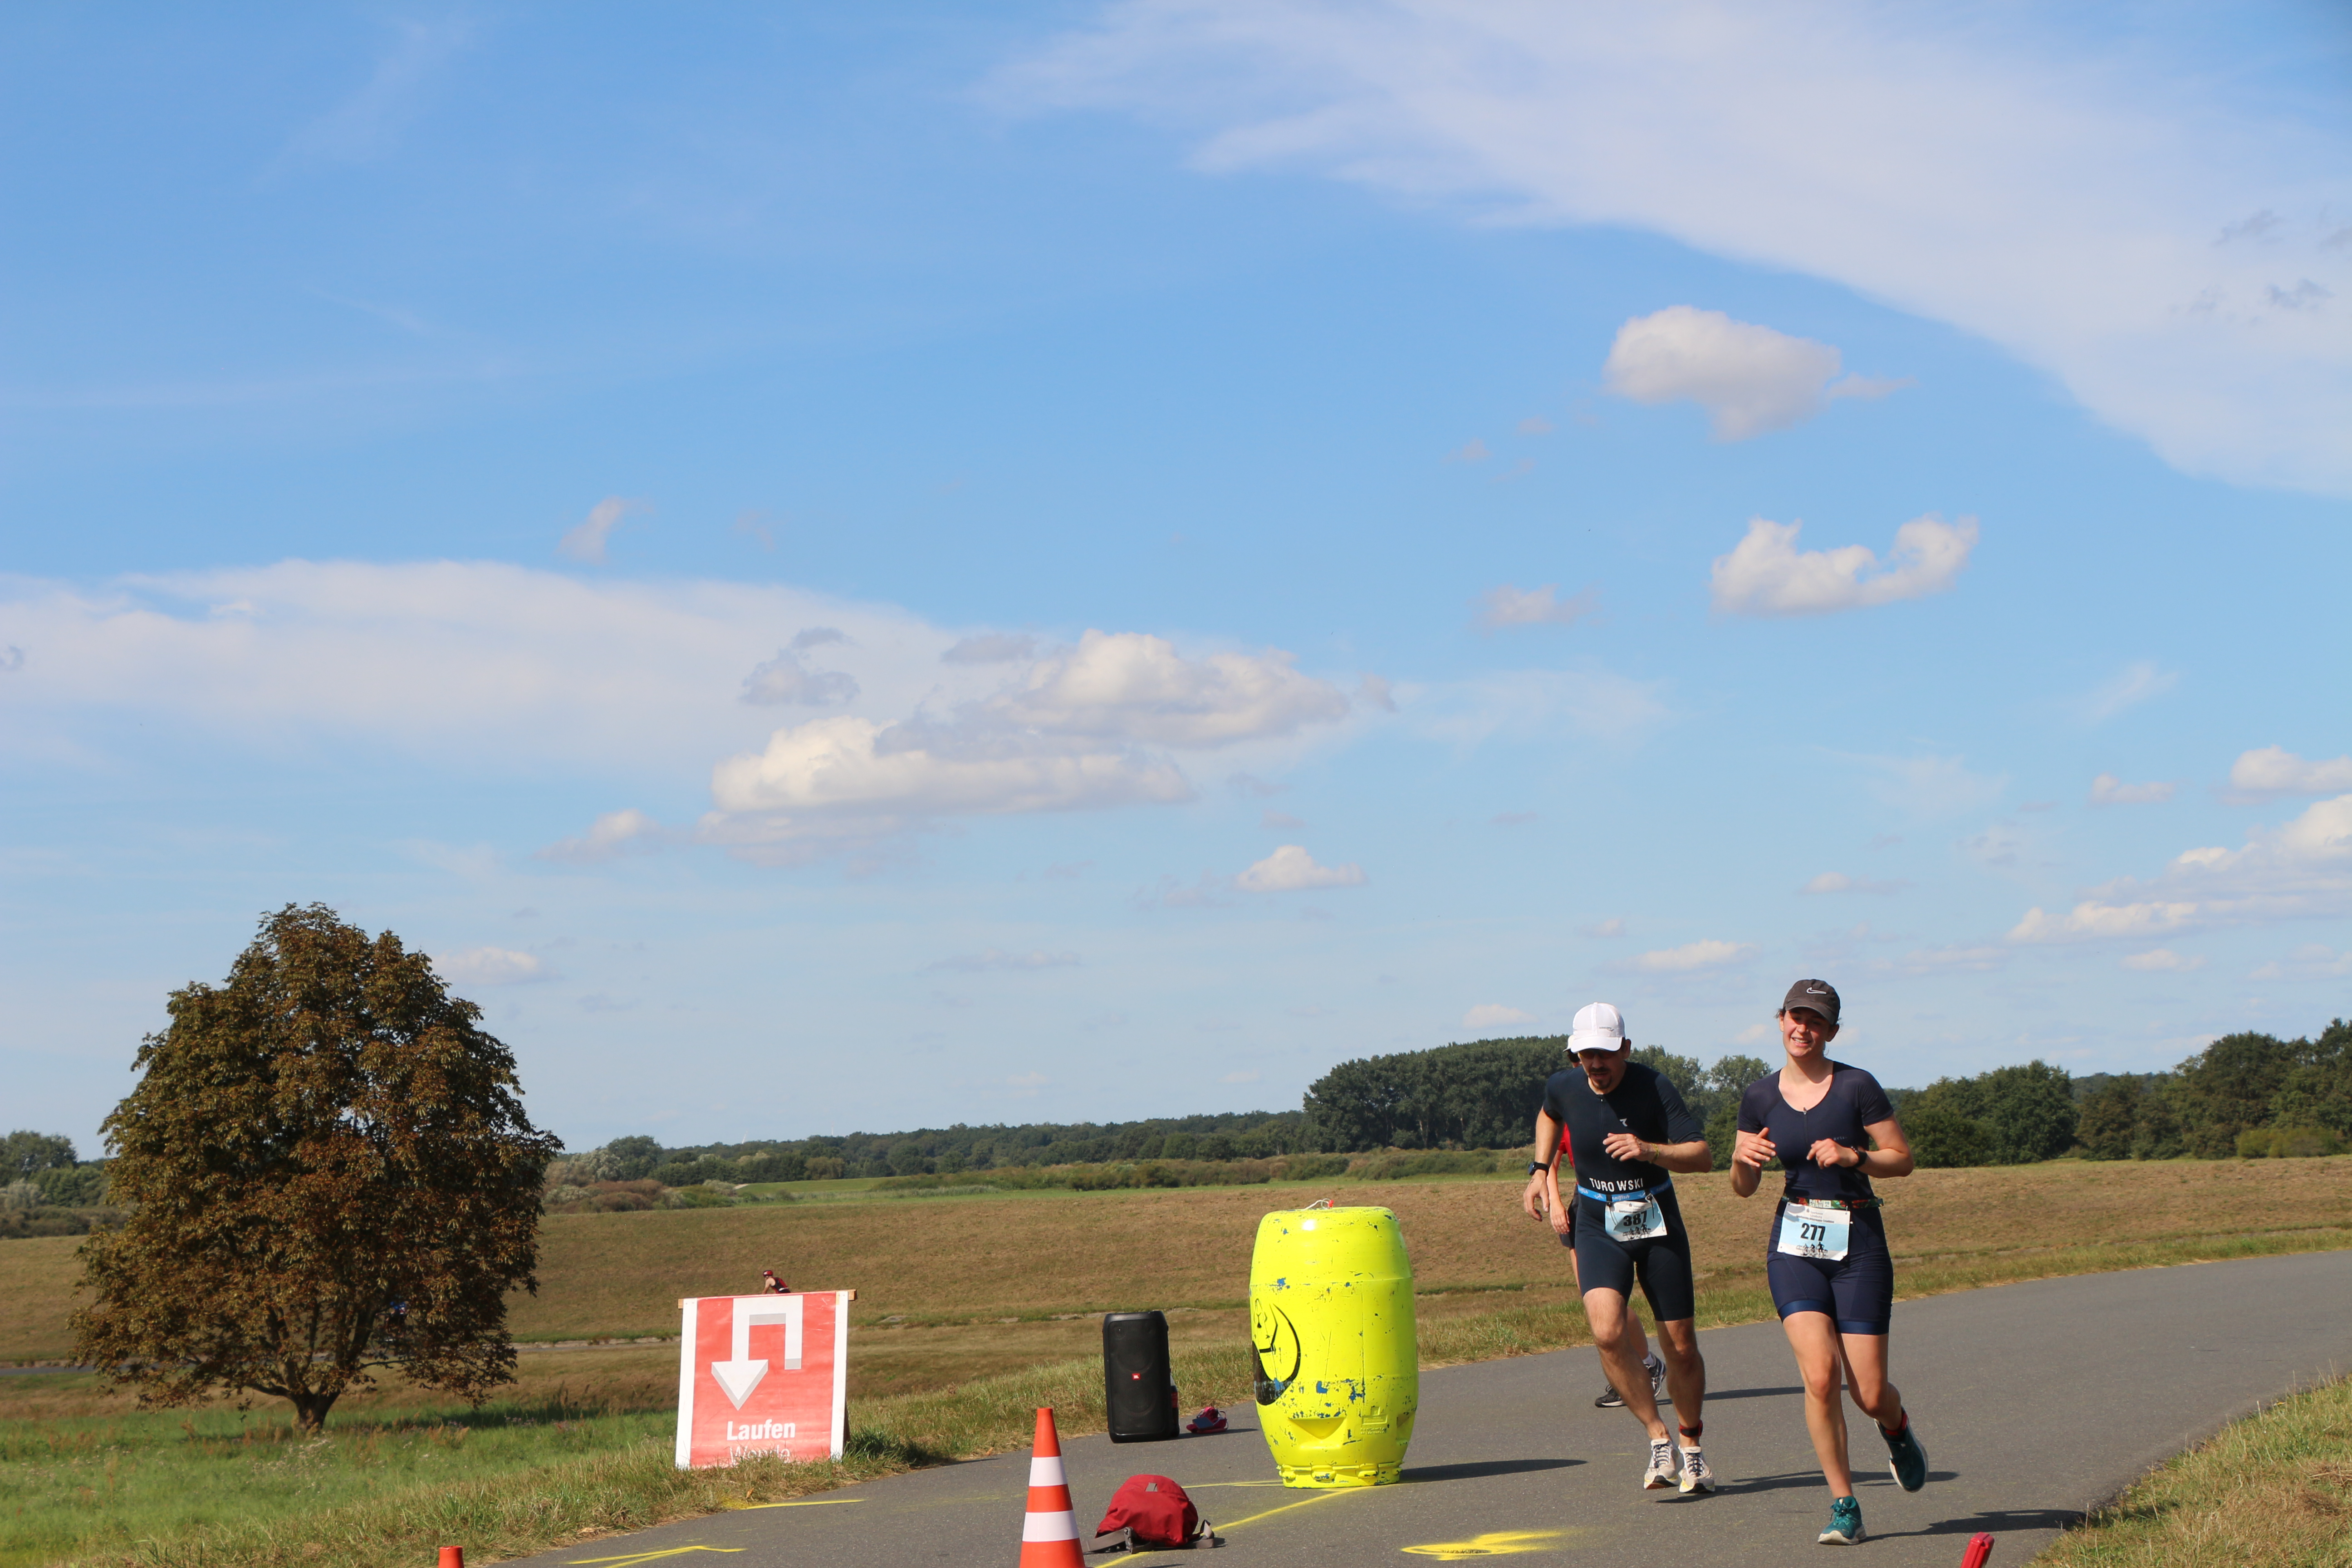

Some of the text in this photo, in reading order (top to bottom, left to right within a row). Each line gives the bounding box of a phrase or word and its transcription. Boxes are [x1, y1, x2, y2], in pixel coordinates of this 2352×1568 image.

[1623, 1210, 1647, 1226] 387
[1800, 1223, 1826, 1241] 277
[727, 1419, 795, 1441] Laufen
